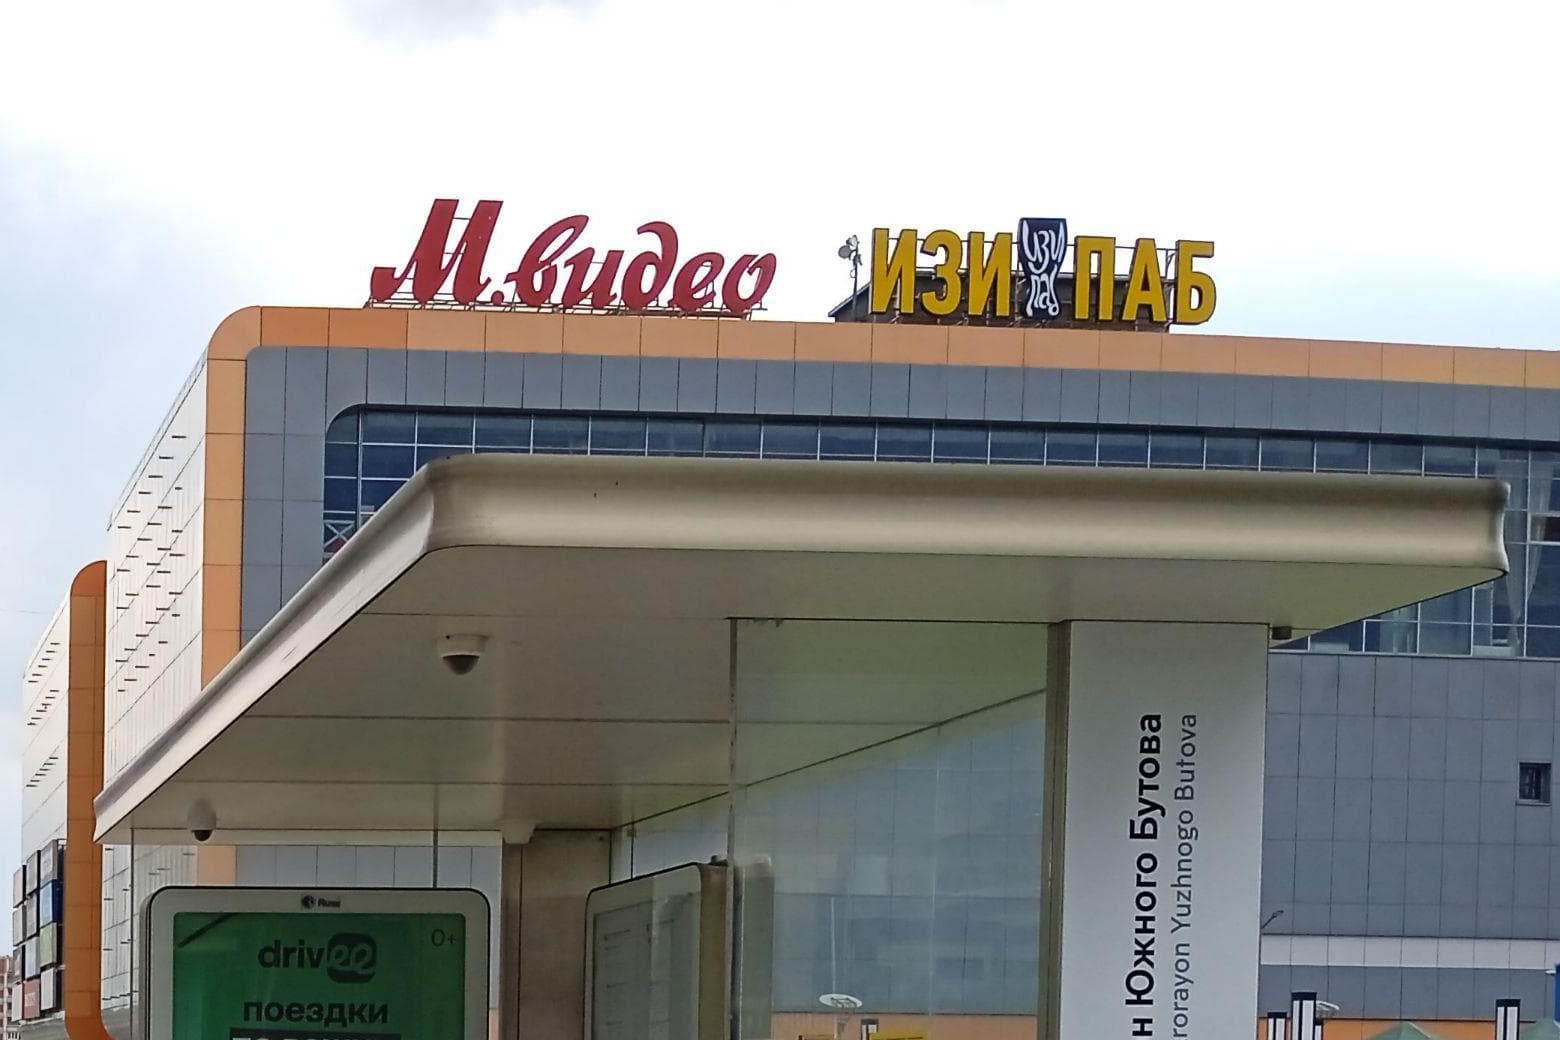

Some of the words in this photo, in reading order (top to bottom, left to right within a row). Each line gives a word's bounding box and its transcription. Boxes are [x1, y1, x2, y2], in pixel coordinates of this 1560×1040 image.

[371, 198, 777, 313] М.видео
[871, 227, 1013, 317] ИЗИ
[1073, 235, 1217, 325] ПАБ
[1129, 713, 1166, 840] Бутова
[1174, 714, 1197, 800] Butova
[1124, 852, 1158, 1005] Южного
[1170, 809, 1199, 934] Yuzhnogo
[243, 1001, 389, 1028] поездки
